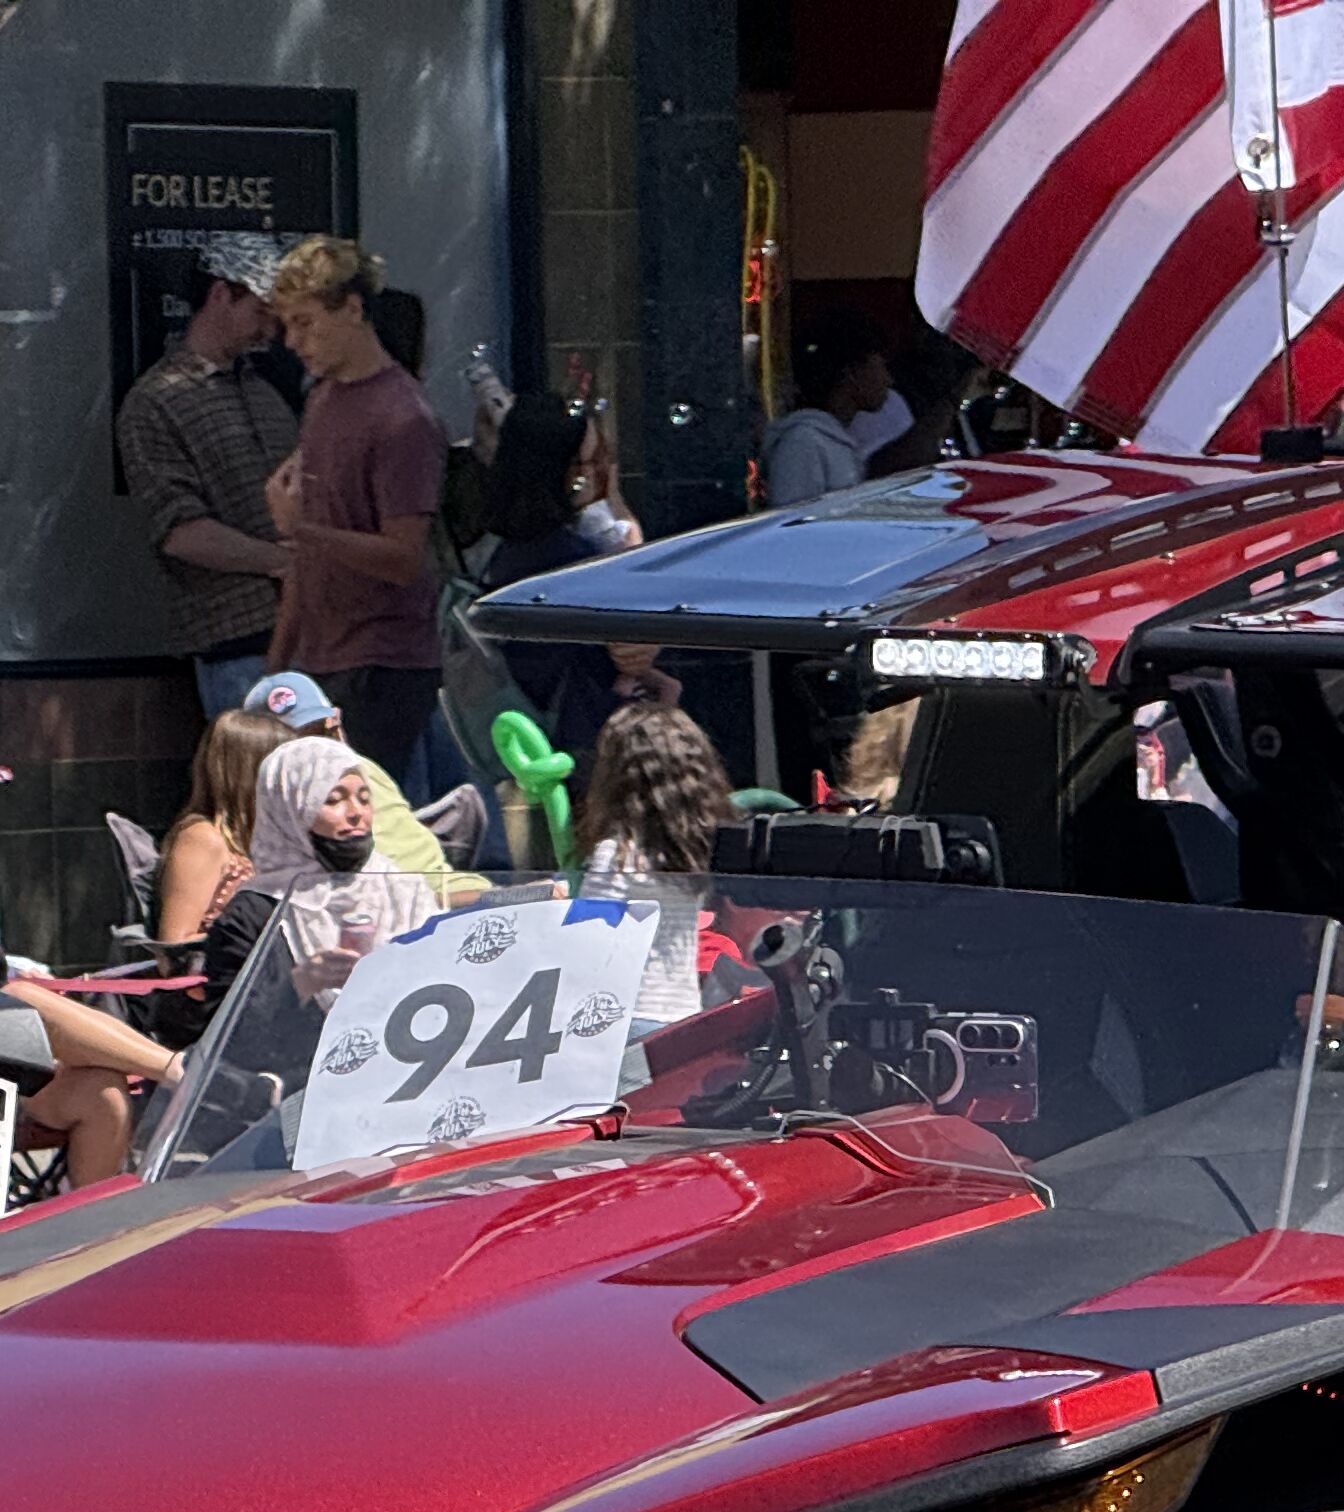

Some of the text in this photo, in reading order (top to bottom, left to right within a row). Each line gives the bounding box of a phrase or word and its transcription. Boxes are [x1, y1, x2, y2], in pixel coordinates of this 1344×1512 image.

[132, 174, 274, 209] FOR LEASE
[466, 933, 499, 957] JULY
[383, 967, 563, 1105] 94
